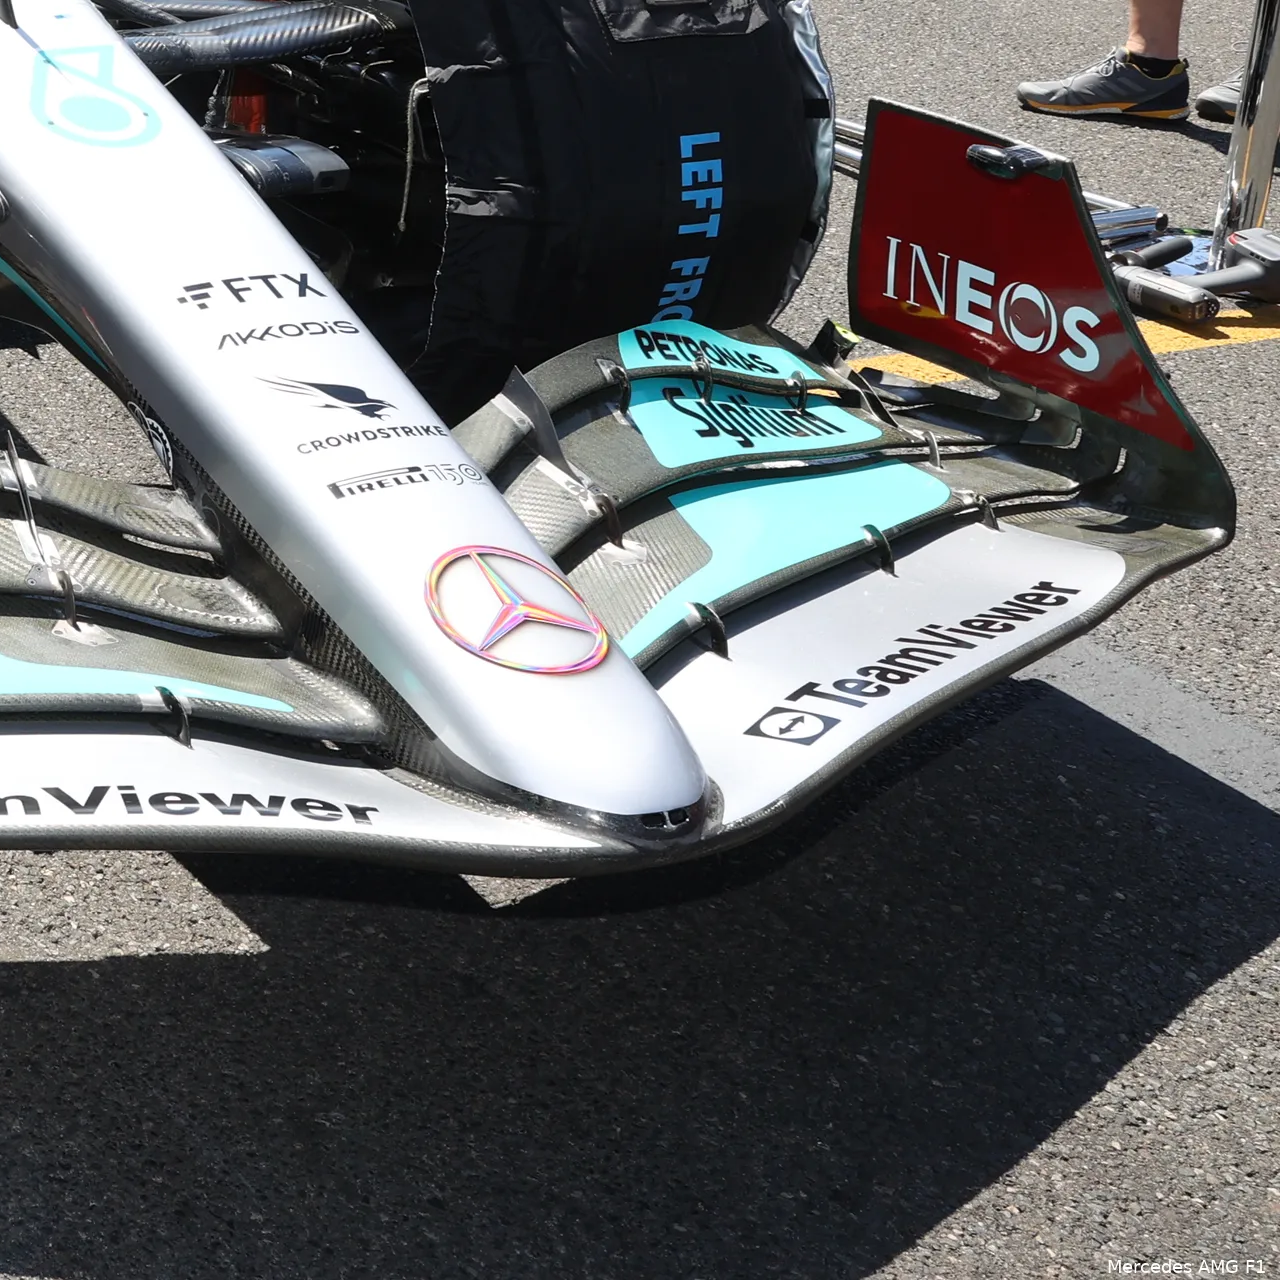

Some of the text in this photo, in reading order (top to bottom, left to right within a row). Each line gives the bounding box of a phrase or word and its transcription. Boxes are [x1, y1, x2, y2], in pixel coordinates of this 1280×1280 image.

[651, 132, 723, 322] LEFT FRO
[221, 273, 328, 303] FTX
[883, 235, 1100, 372] INEOS
[634, 329, 780, 375] PETRONAS
[297, 424, 450, 455] CROWDSTRIKE
[663, 386, 846, 448] Syntium
[326, 466, 429, 499] PIRELLI
[789, 579, 1082, 709] TeamViewer
